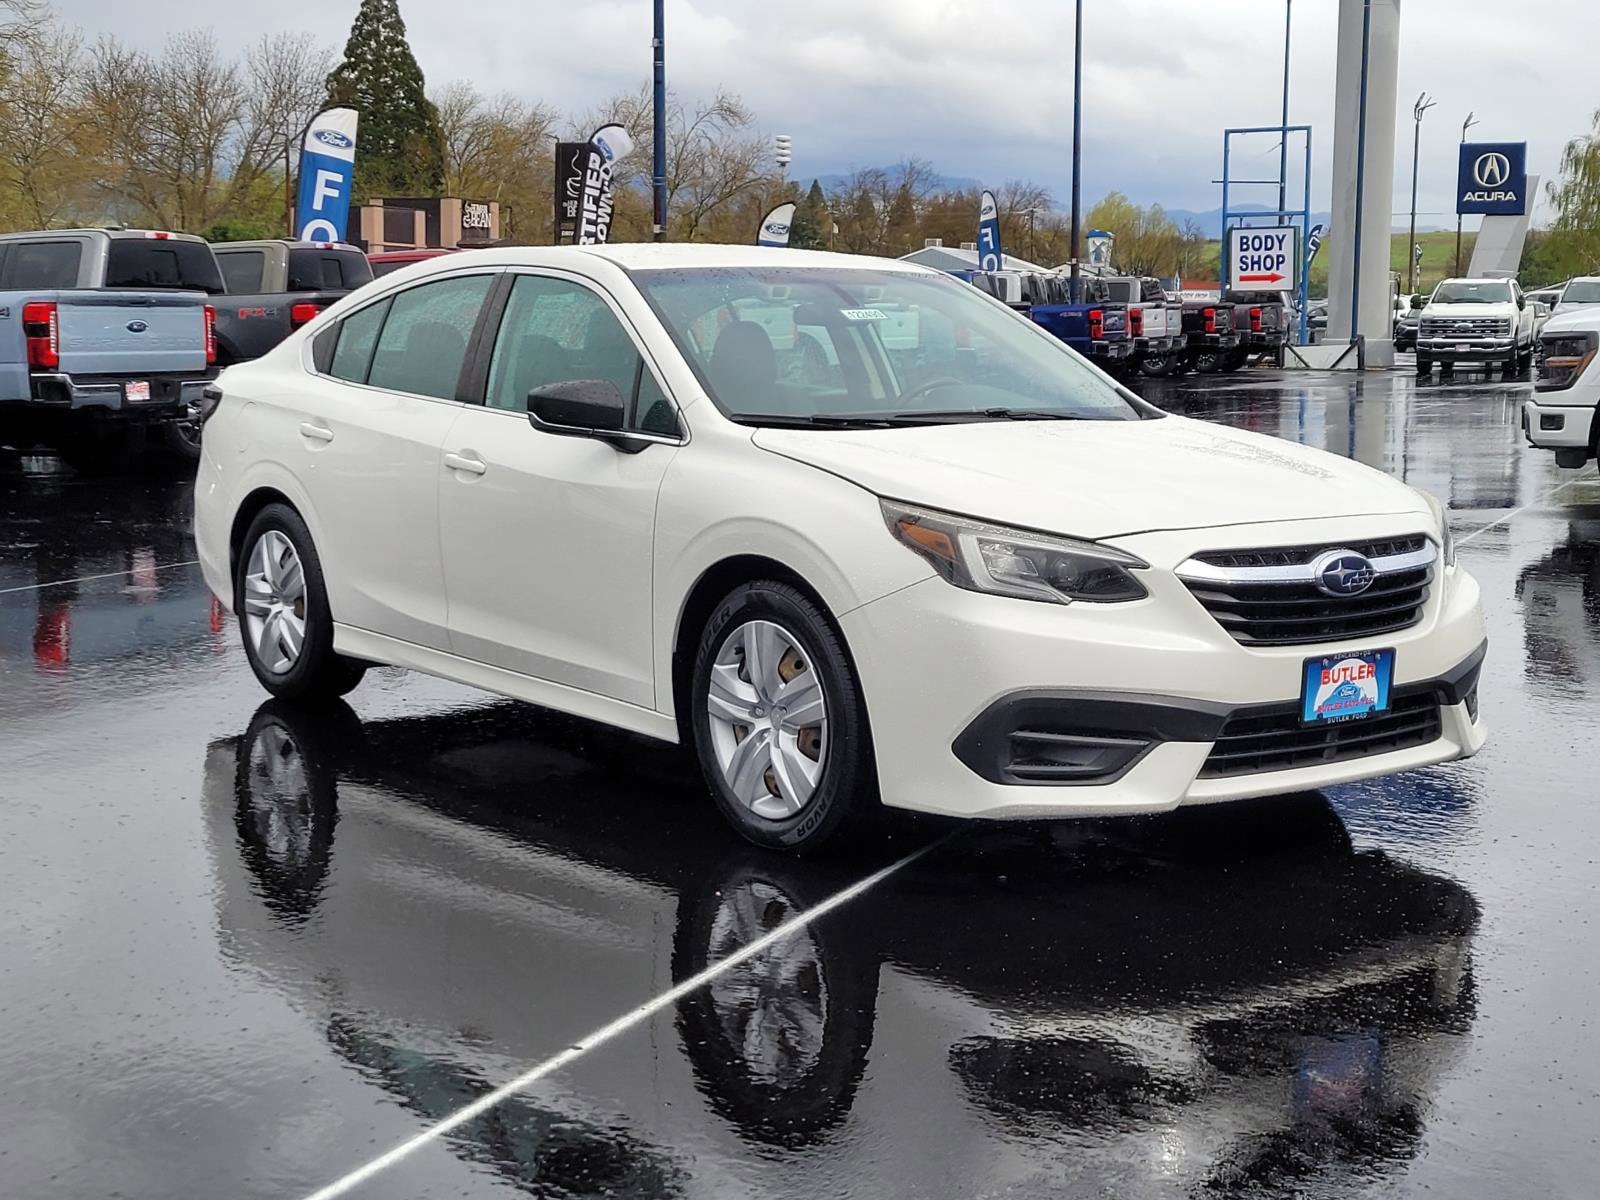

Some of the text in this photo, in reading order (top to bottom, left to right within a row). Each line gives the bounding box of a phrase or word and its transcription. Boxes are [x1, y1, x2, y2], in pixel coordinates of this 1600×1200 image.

[1462, 191, 1517, 201] ACURA
[1240, 234, 1287, 252] BODY
[1239, 254, 1285, 271] SHOP
[1322, 664, 1375, 685] BUTLER
